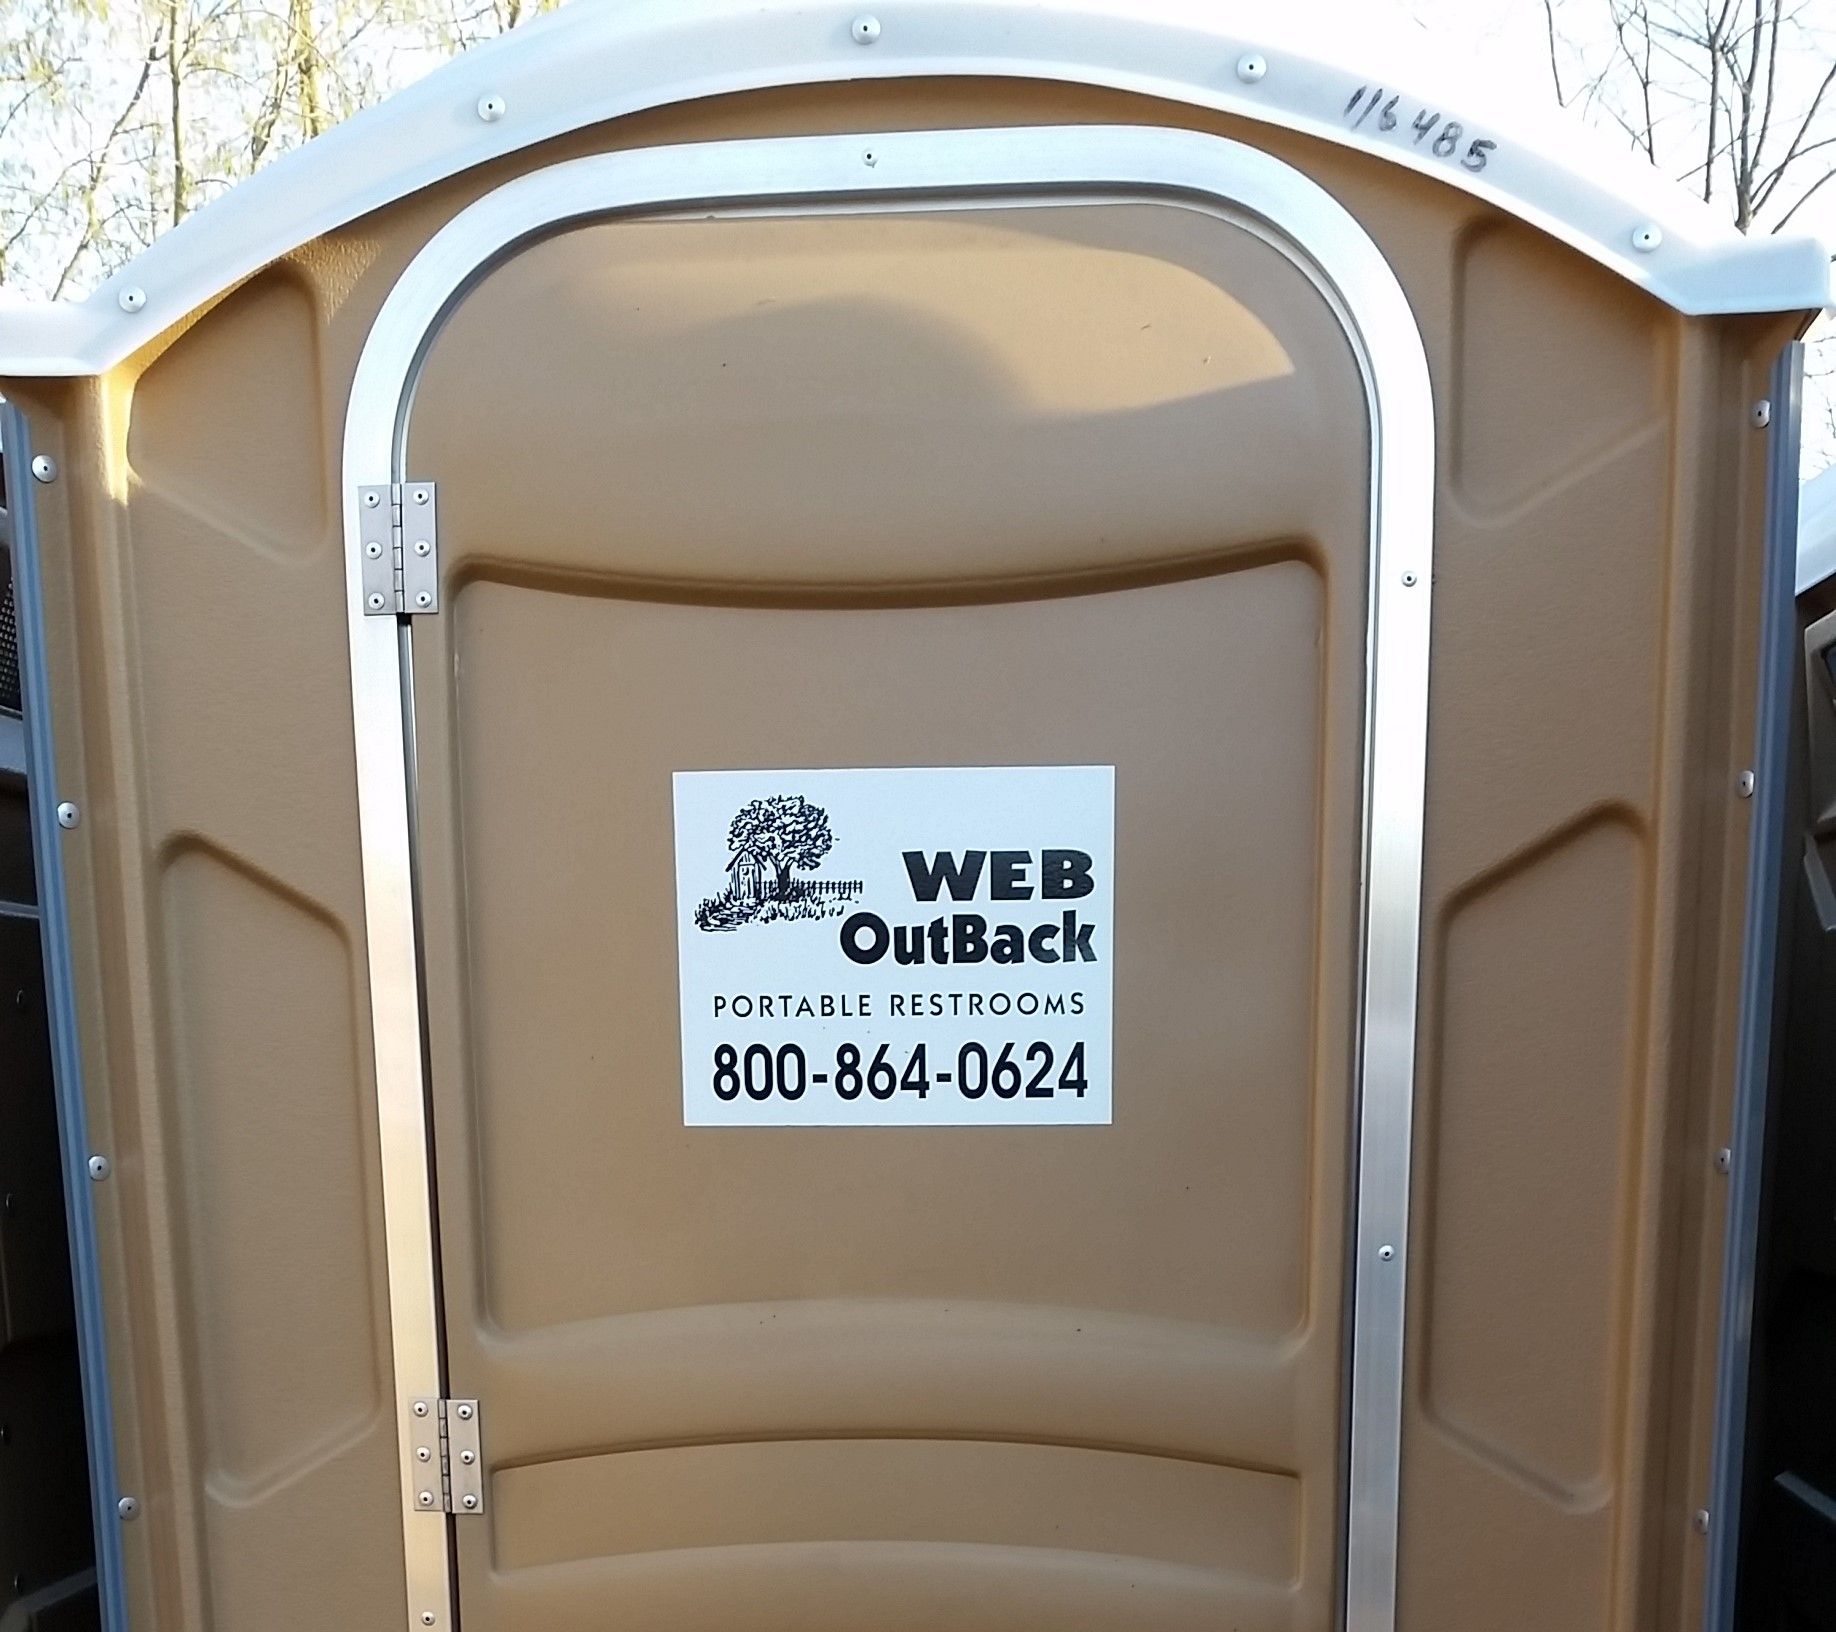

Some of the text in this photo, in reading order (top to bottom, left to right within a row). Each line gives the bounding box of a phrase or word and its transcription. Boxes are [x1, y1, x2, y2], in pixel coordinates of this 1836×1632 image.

[902, 849, 1095, 902] WEB
[839, 909, 1098, 966] OutBack
[714, 991, 1085, 1018] PORTABLE RESTROOMS
[712, 1041, 1088, 1102] 800-864-0624
